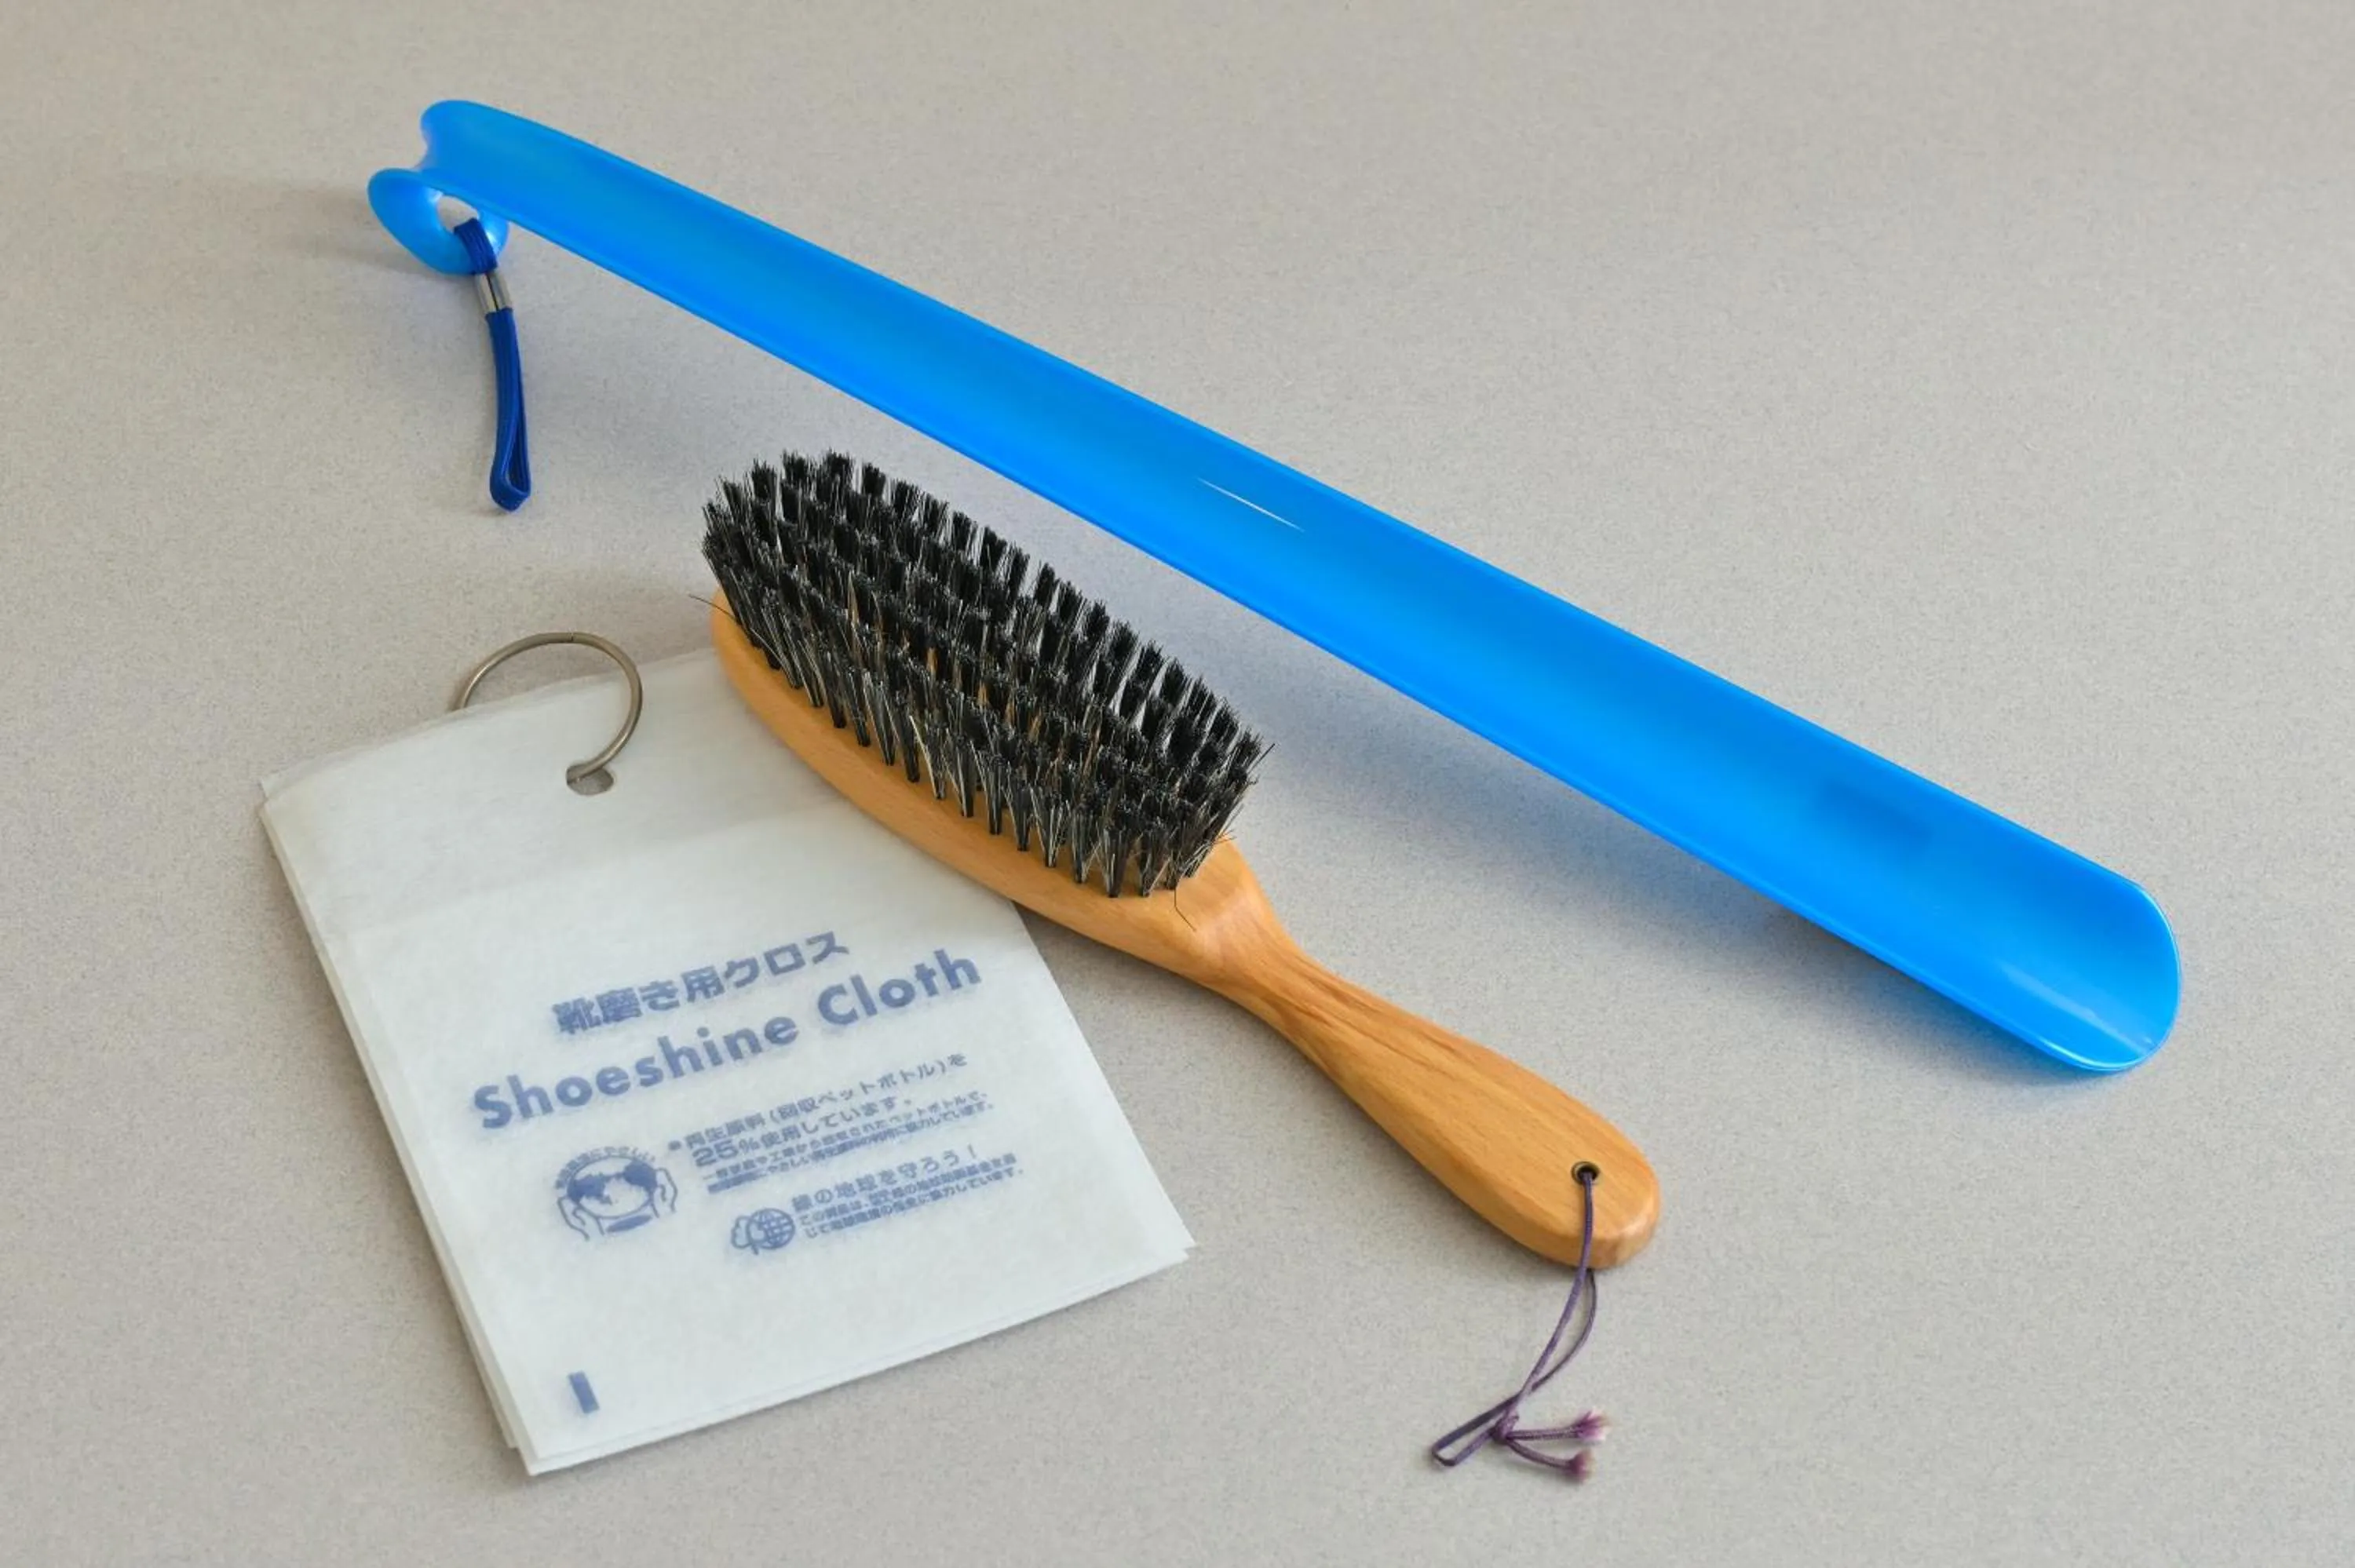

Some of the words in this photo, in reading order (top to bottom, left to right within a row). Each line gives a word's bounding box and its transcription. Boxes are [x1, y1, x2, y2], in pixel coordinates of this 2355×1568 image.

[474, 1017, 799, 1129] Shoeshine
[818, 948, 981, 1025] Cloth
[552, 931, 849, 1034] 靴磨き用クロス
